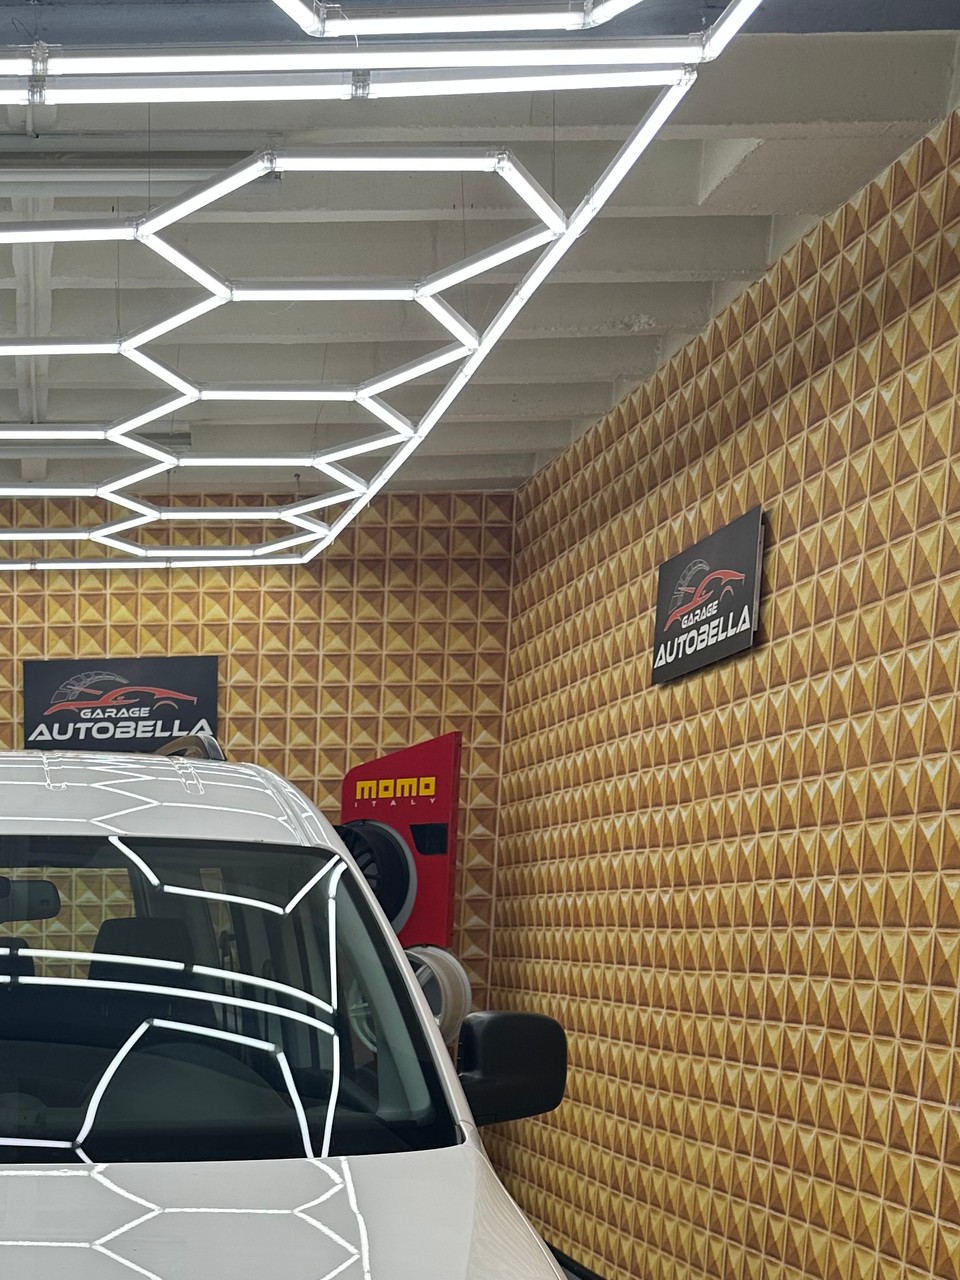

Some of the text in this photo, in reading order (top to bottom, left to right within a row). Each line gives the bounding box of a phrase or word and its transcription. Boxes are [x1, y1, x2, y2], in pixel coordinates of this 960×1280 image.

[681, 600, 719, 629] GARAGE
[653, 604, 751, 669] AUTOBELLA
[80, 707, 150, 719] GARAGE
[28, 718, 214, 741] AUTOBELLA
[354, 798, 437, 808] ITALY
